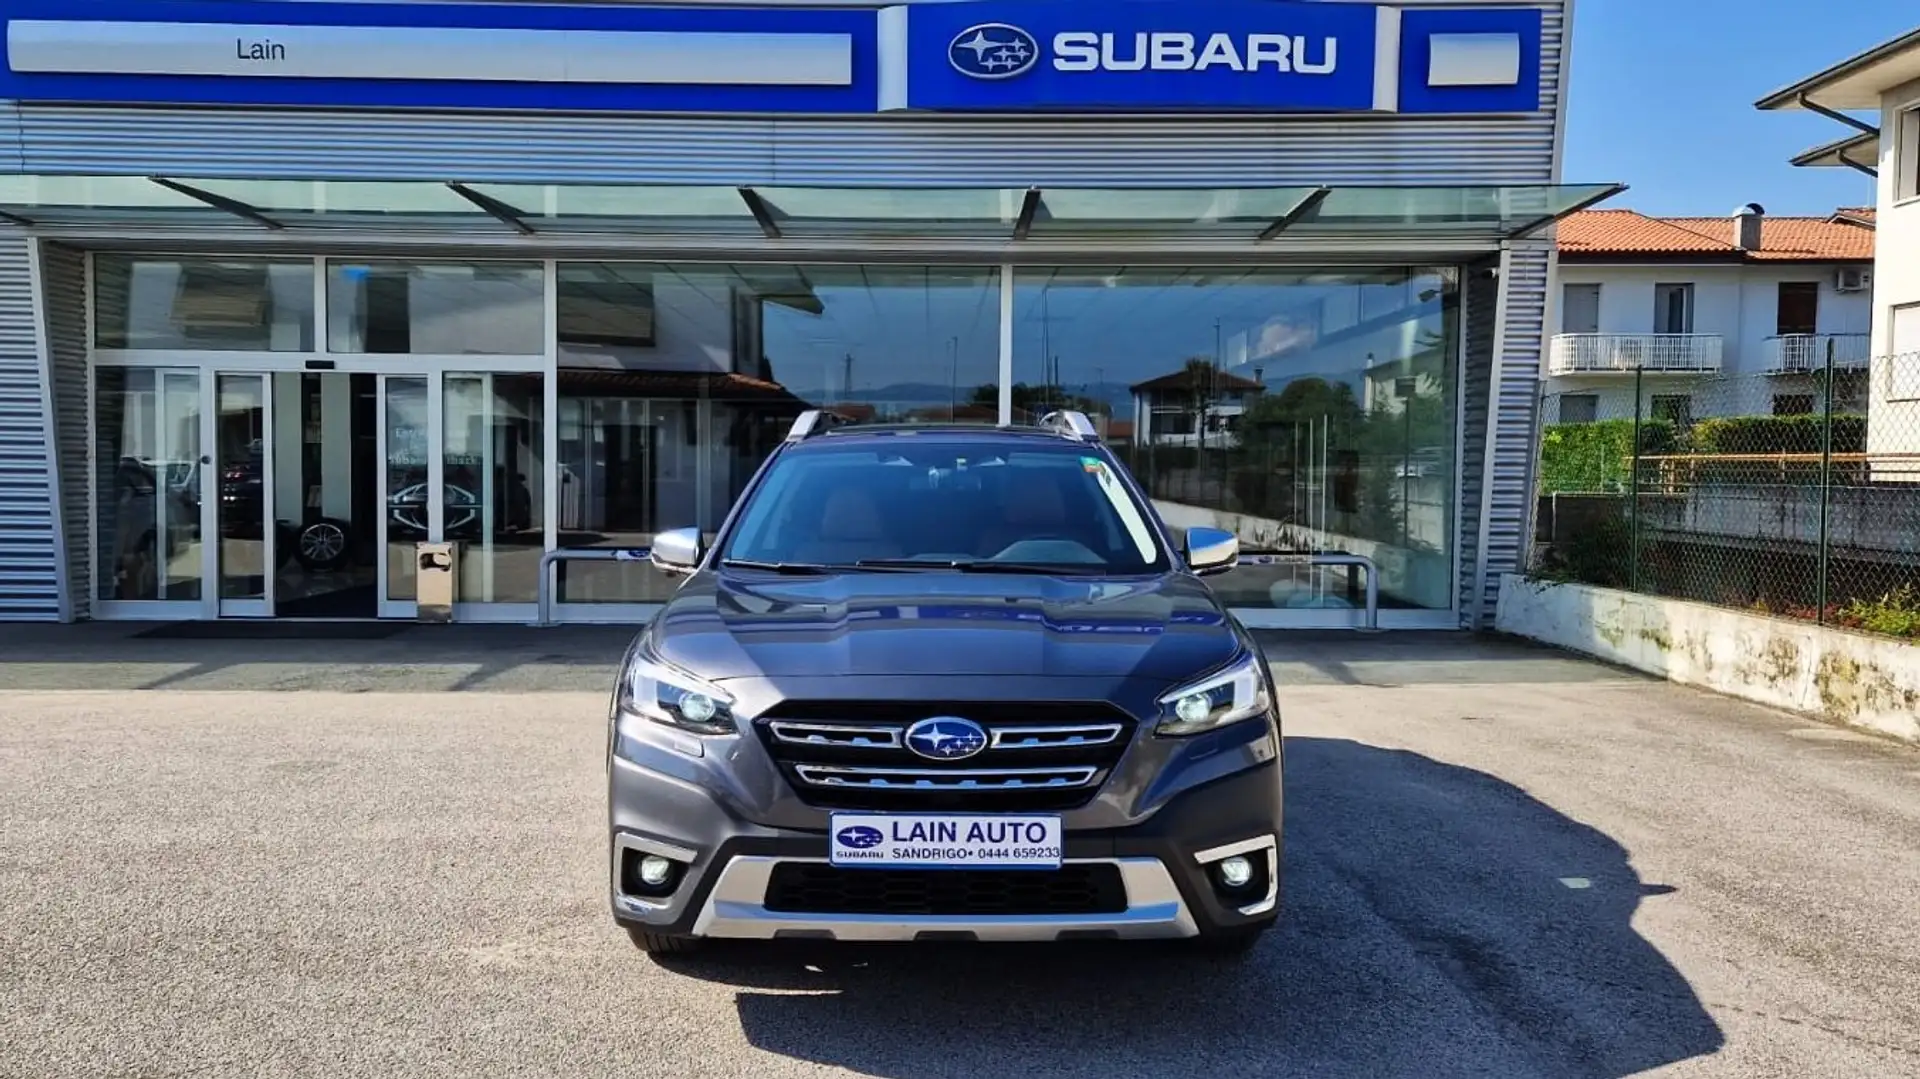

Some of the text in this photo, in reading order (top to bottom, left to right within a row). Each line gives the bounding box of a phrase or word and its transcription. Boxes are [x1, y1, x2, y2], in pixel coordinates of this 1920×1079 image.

[237, 38, 285, 60] Lain
[1053, 32, 1337, 74] SUBARU
[892, 821, 1047, 844] LAIN AUTO
[836, 850, 884, 859] SUBARU
[977, 848, 1009, 859] 0444
[1013, 847, 1061, 859] 659233
